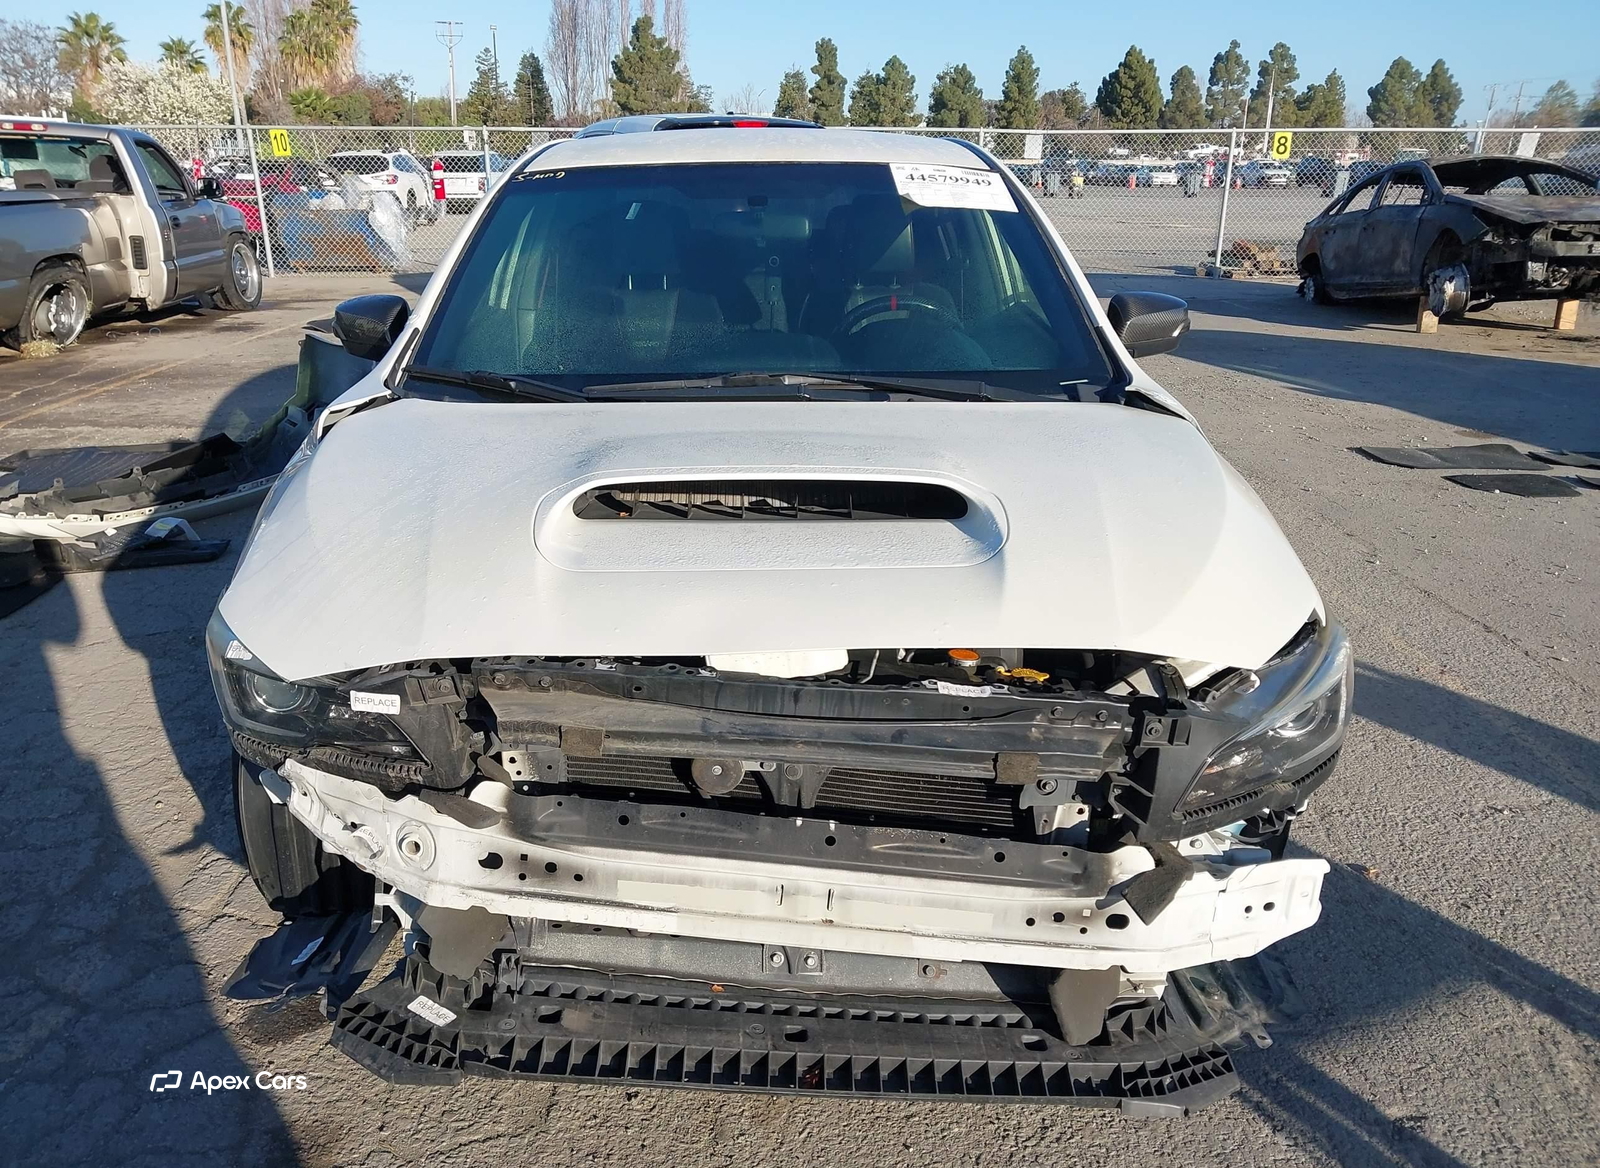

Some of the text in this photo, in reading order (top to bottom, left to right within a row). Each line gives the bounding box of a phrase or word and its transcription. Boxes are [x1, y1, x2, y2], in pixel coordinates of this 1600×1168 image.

[273, 132, 288, 152] 10
[1275, 135, 1289, 155] 8
[905, 173, 992, 187] 44579949
[354, 696, 398, 708] REPLACE
[416, 1000, 451, 1023] REPLACE
